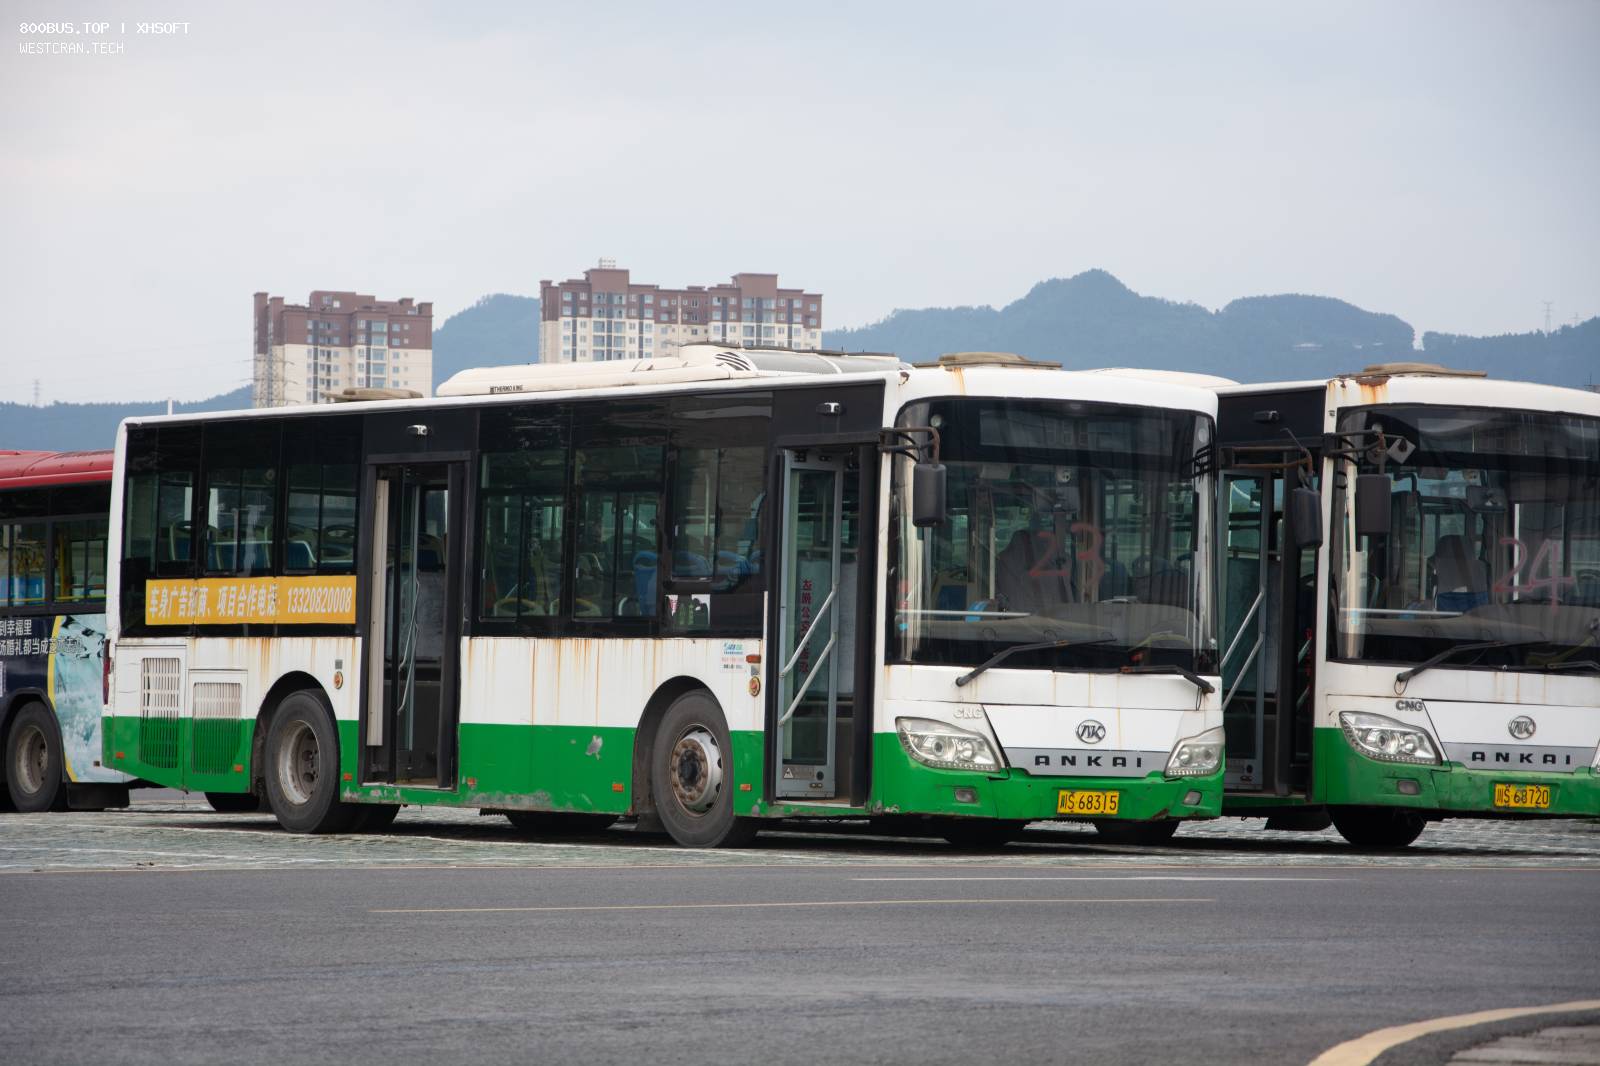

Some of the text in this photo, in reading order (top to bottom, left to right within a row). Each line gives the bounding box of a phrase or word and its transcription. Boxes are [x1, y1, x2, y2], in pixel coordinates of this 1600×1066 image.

[1027, 522, 1105, 590] 23
[1492, 538, 1575, 616] 24
[1395, 699, 1423, 712] CNG
[1034, 755, 1142, 769] ANKAI
[1471, 751, 1571, 765] ANKAI
